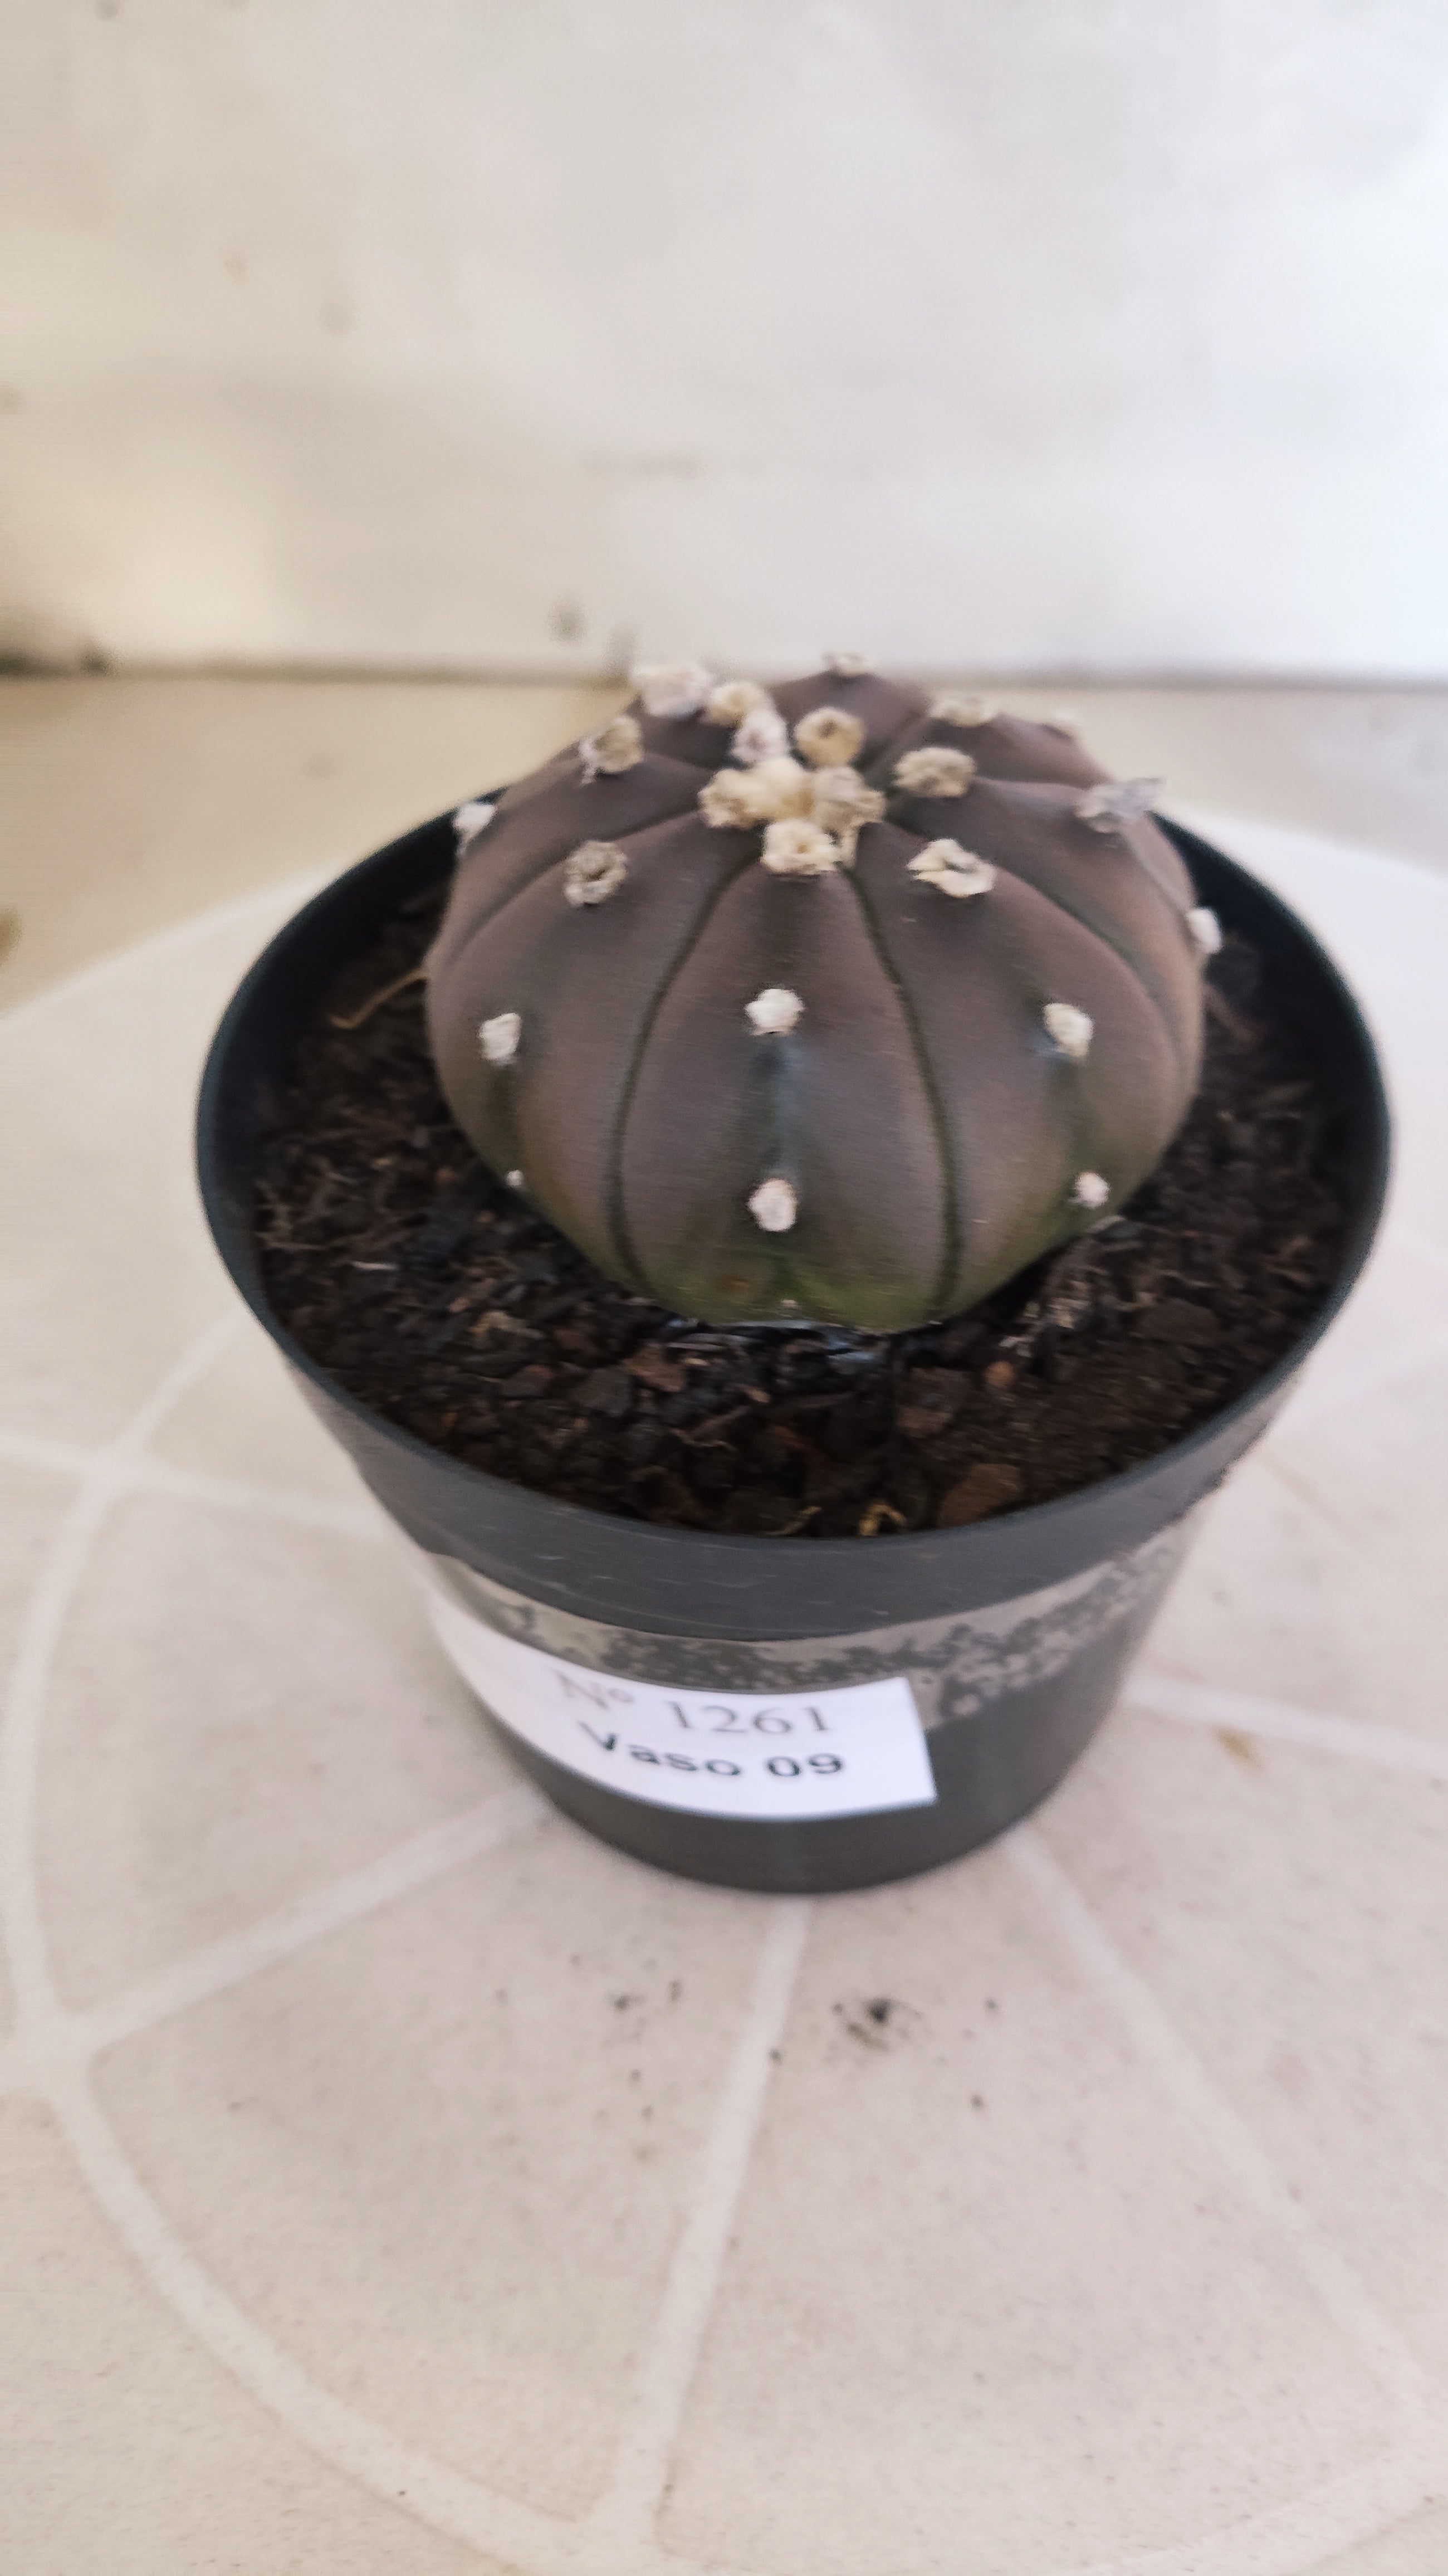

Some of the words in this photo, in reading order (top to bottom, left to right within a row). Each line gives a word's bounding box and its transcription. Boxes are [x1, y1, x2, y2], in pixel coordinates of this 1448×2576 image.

[666, 1700, 831, 1734] 1261
[578, 1721, 743, 1777] Vaso
[766, 1752, 844, 1778] 09
